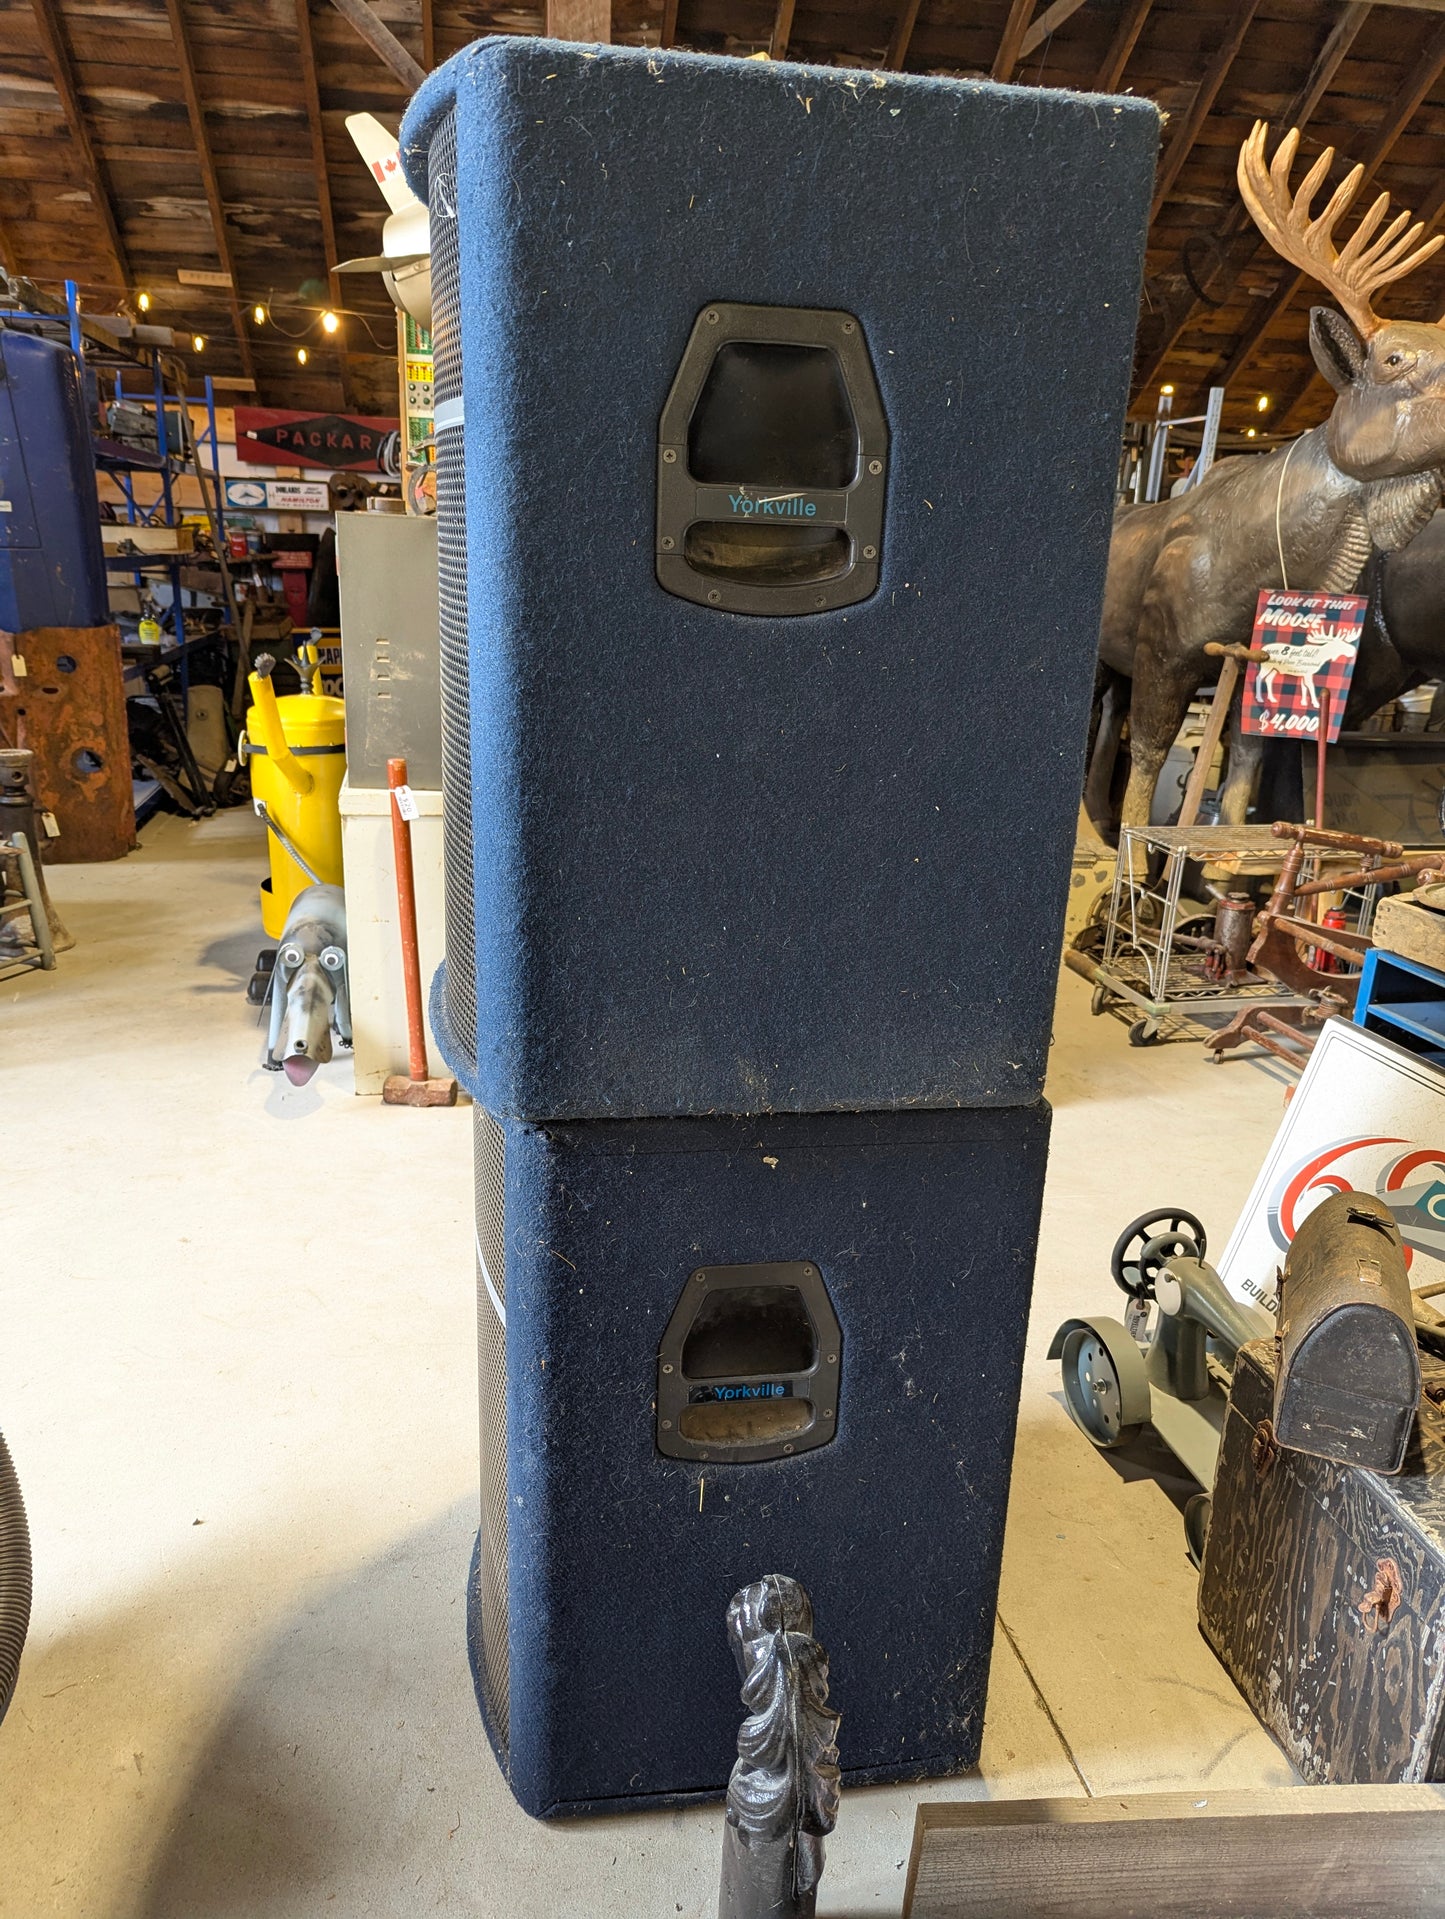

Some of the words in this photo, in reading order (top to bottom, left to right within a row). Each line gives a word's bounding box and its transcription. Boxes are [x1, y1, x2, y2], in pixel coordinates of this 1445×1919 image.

[276, 429, 384, 449] PACKAR
[728, 494, 817, 516] Yorkville
[1267, 594, 1303, 606] LOOK
[1303, 598, 1322, 609] AT
[1322, 600, 1357, 610] THAT
[1257, 608, 1326, 629] MOOSE
[318, 648, 342, 665] NAP
[1281, 646, 1290, 655] 8
[1259, 709, 1319, 732] $4,000
[715, 1383, 784, 1399] Yorkville
